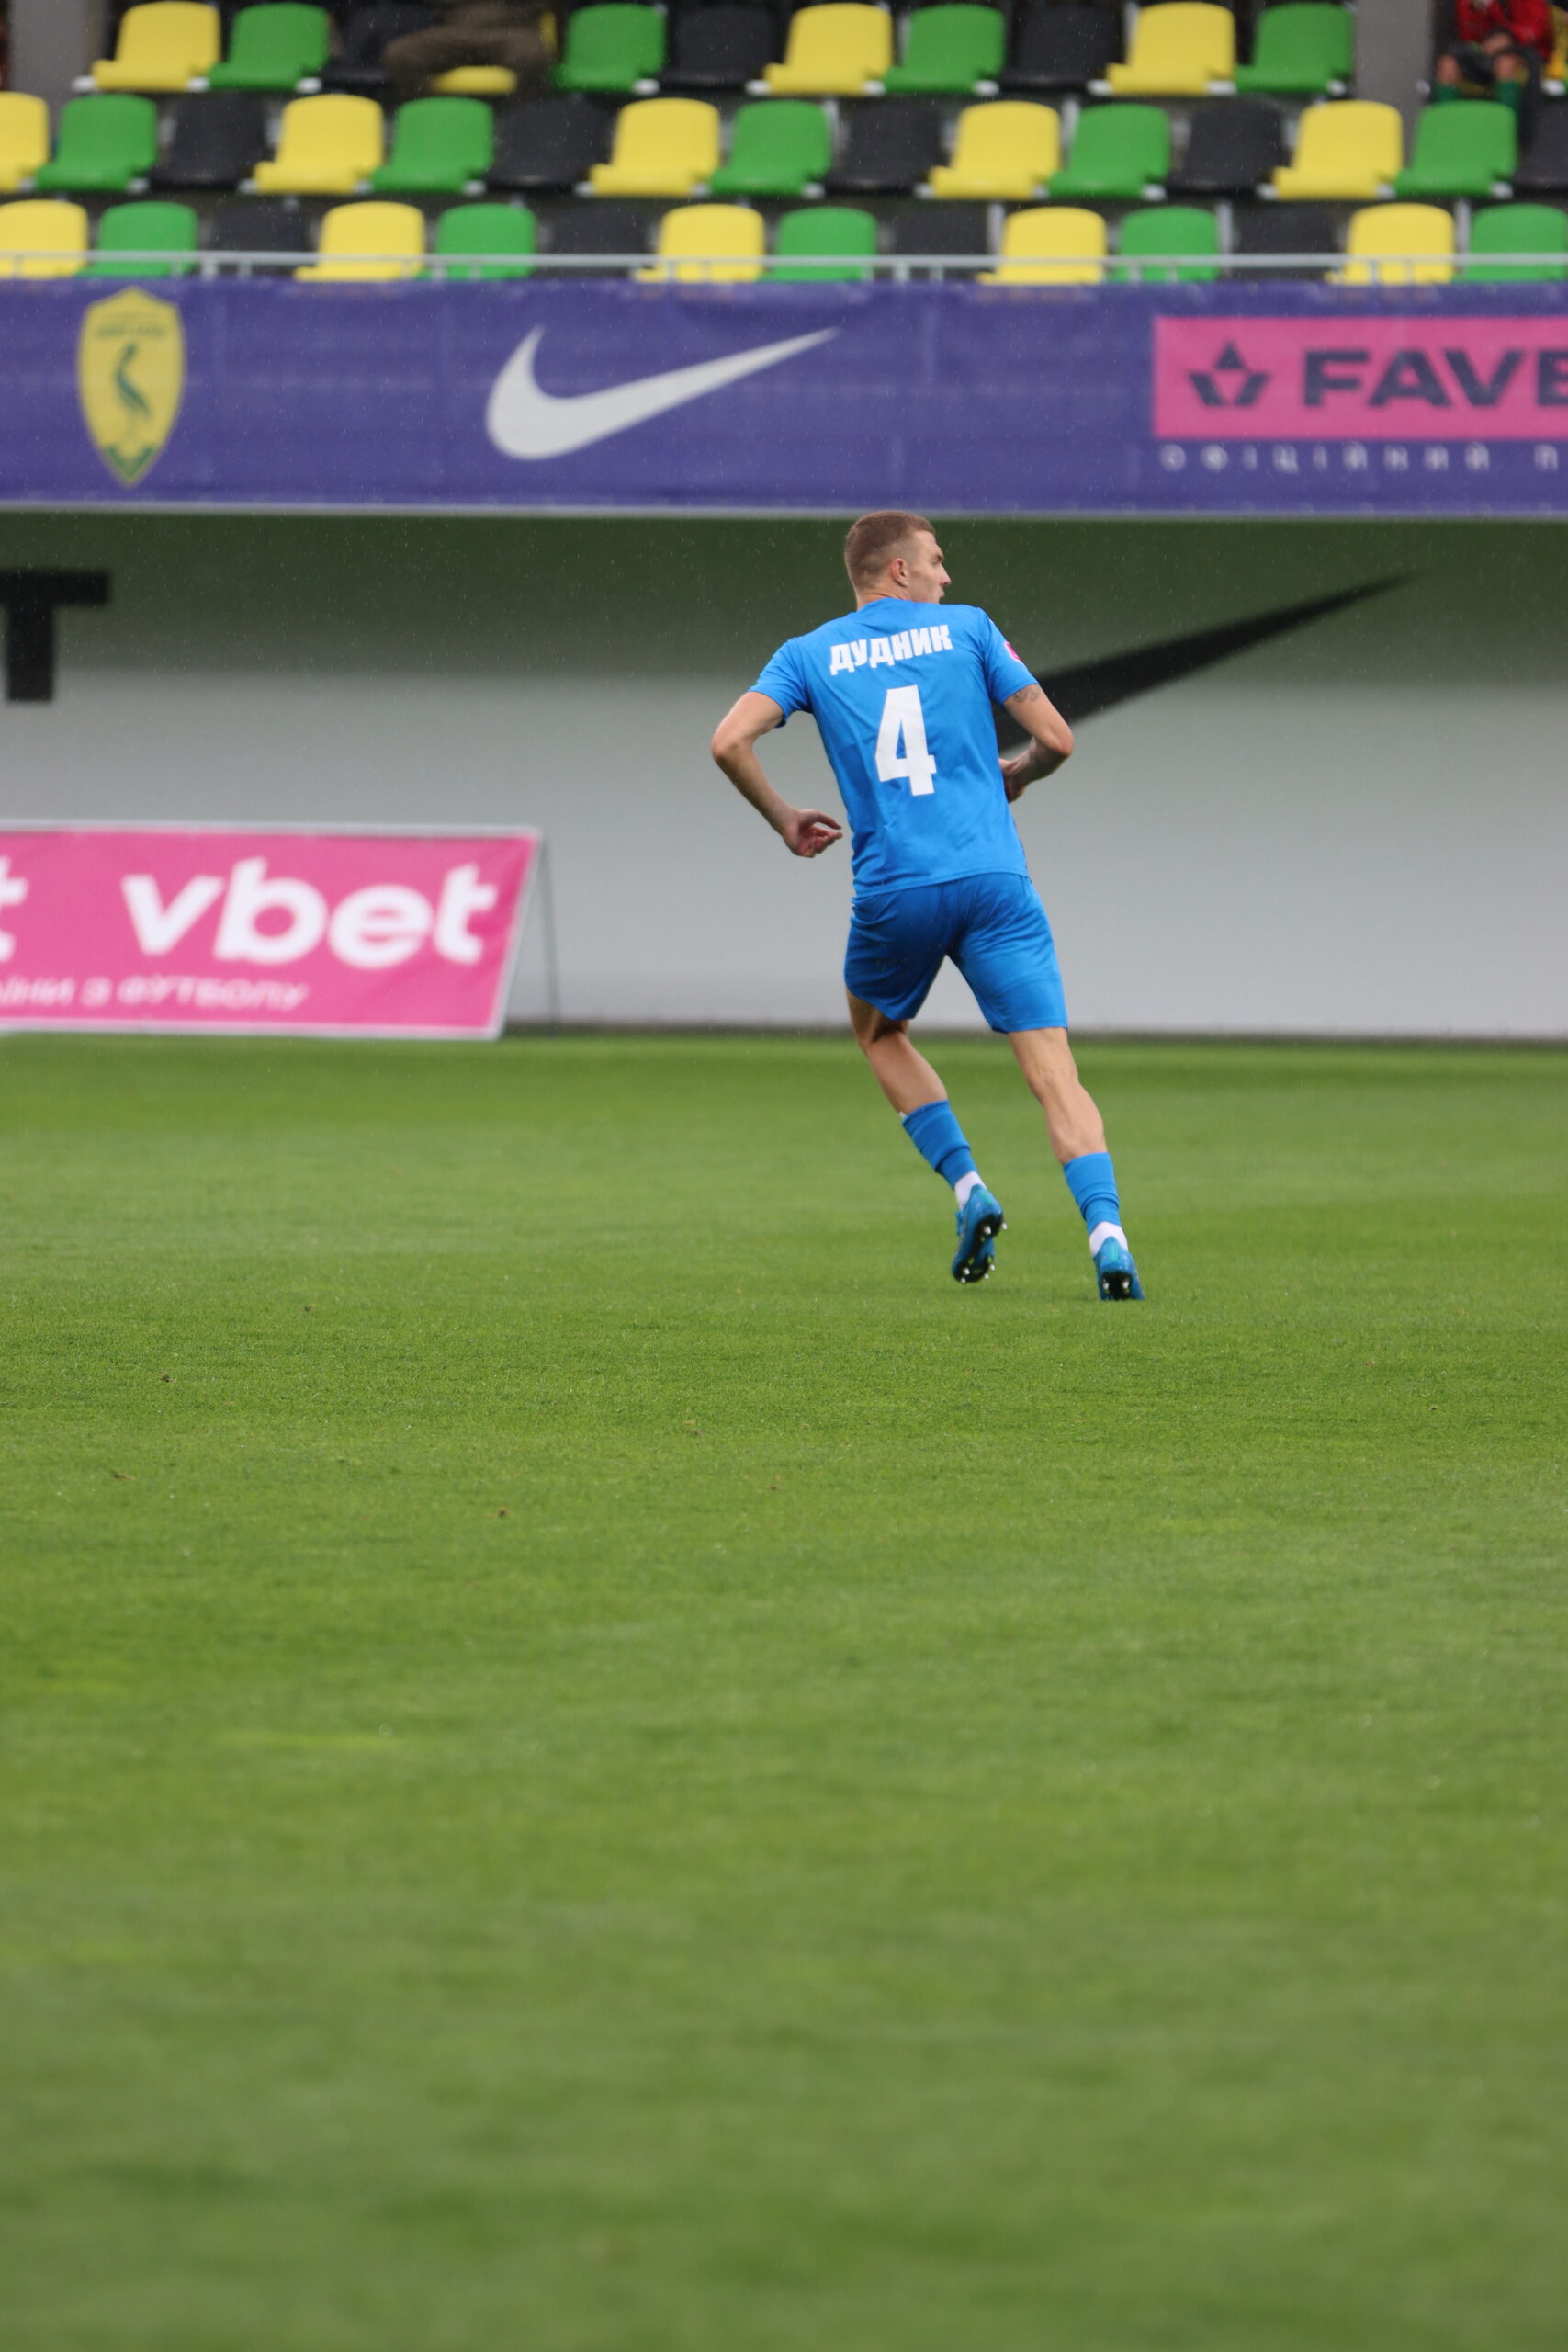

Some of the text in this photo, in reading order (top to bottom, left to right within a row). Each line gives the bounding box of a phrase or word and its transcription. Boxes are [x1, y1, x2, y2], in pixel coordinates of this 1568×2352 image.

[829, 624, 953, 675] ДУДНИК
[874, 684, 937, 797] 4
[120, 856, 498, 968] vbet
